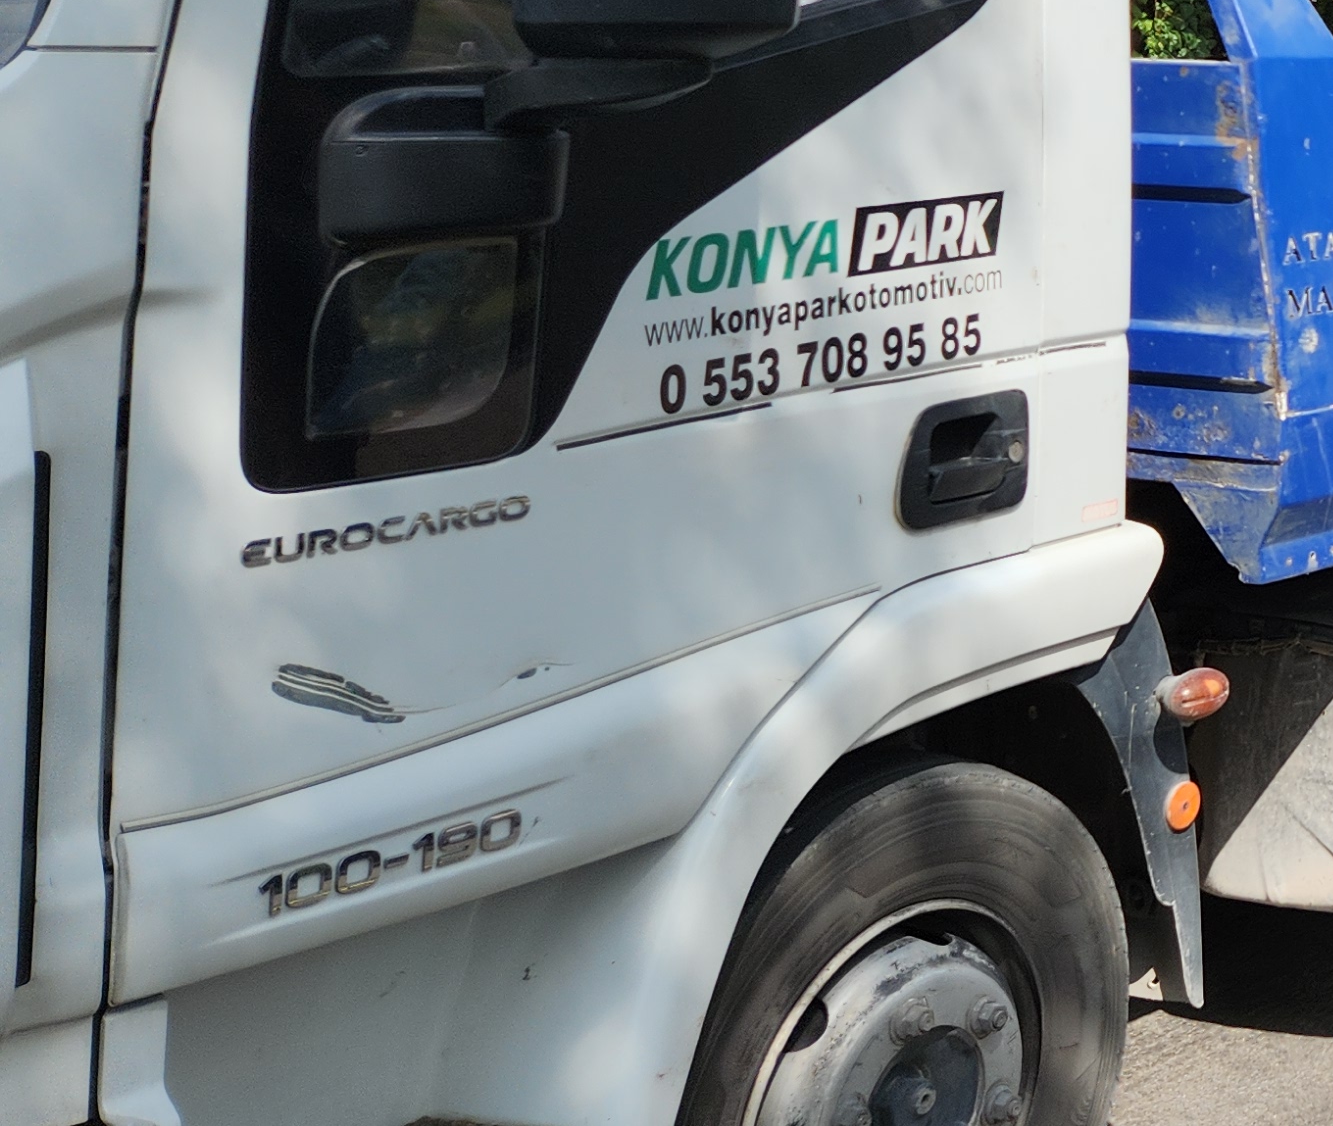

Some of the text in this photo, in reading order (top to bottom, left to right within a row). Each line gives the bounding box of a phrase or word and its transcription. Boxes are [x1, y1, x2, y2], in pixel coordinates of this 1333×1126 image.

[645, 198, 998, 301] KONYA PARK
[645, 269, 1003, 347] www.konyaparkotomotiv.com
[660, 313, 982, 415] 0 553 708 95 85
[240, 495, 531, 569] EUROCARGO
[258, 808, 521, 917] 100-190
